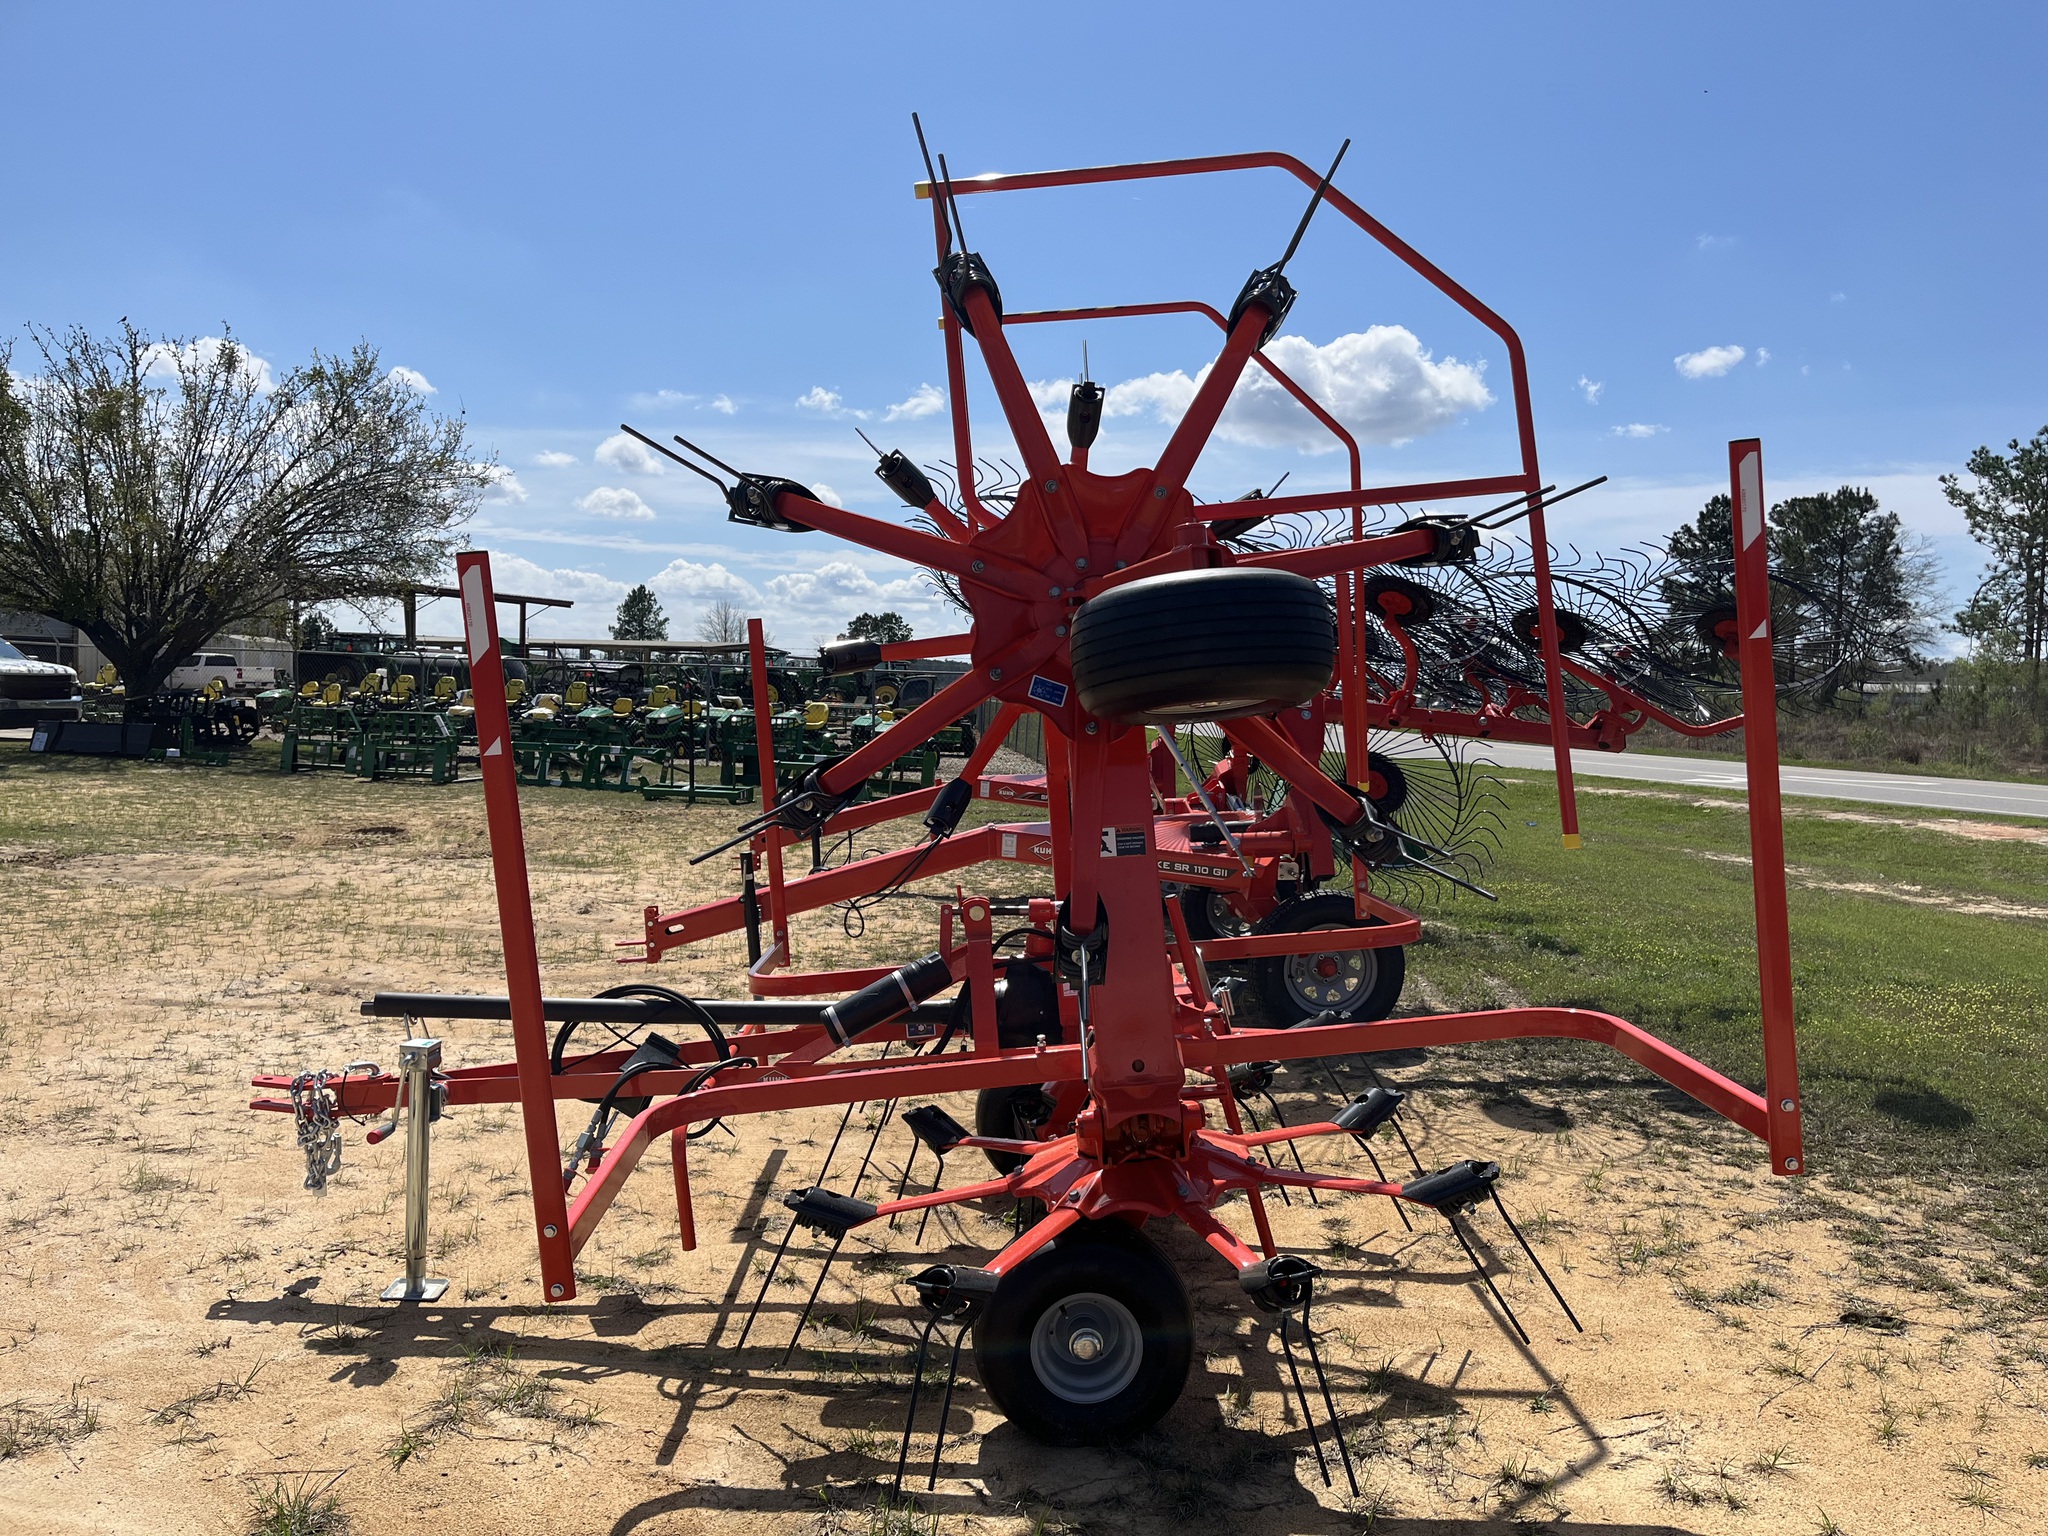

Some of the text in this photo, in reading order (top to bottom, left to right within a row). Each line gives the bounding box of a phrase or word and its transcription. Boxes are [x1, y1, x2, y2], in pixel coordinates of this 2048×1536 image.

[1033, 846, 1052, 855] KUH
[1174, 863, 1190, 872] SR
[1193, 865, 1209, 874] 110
